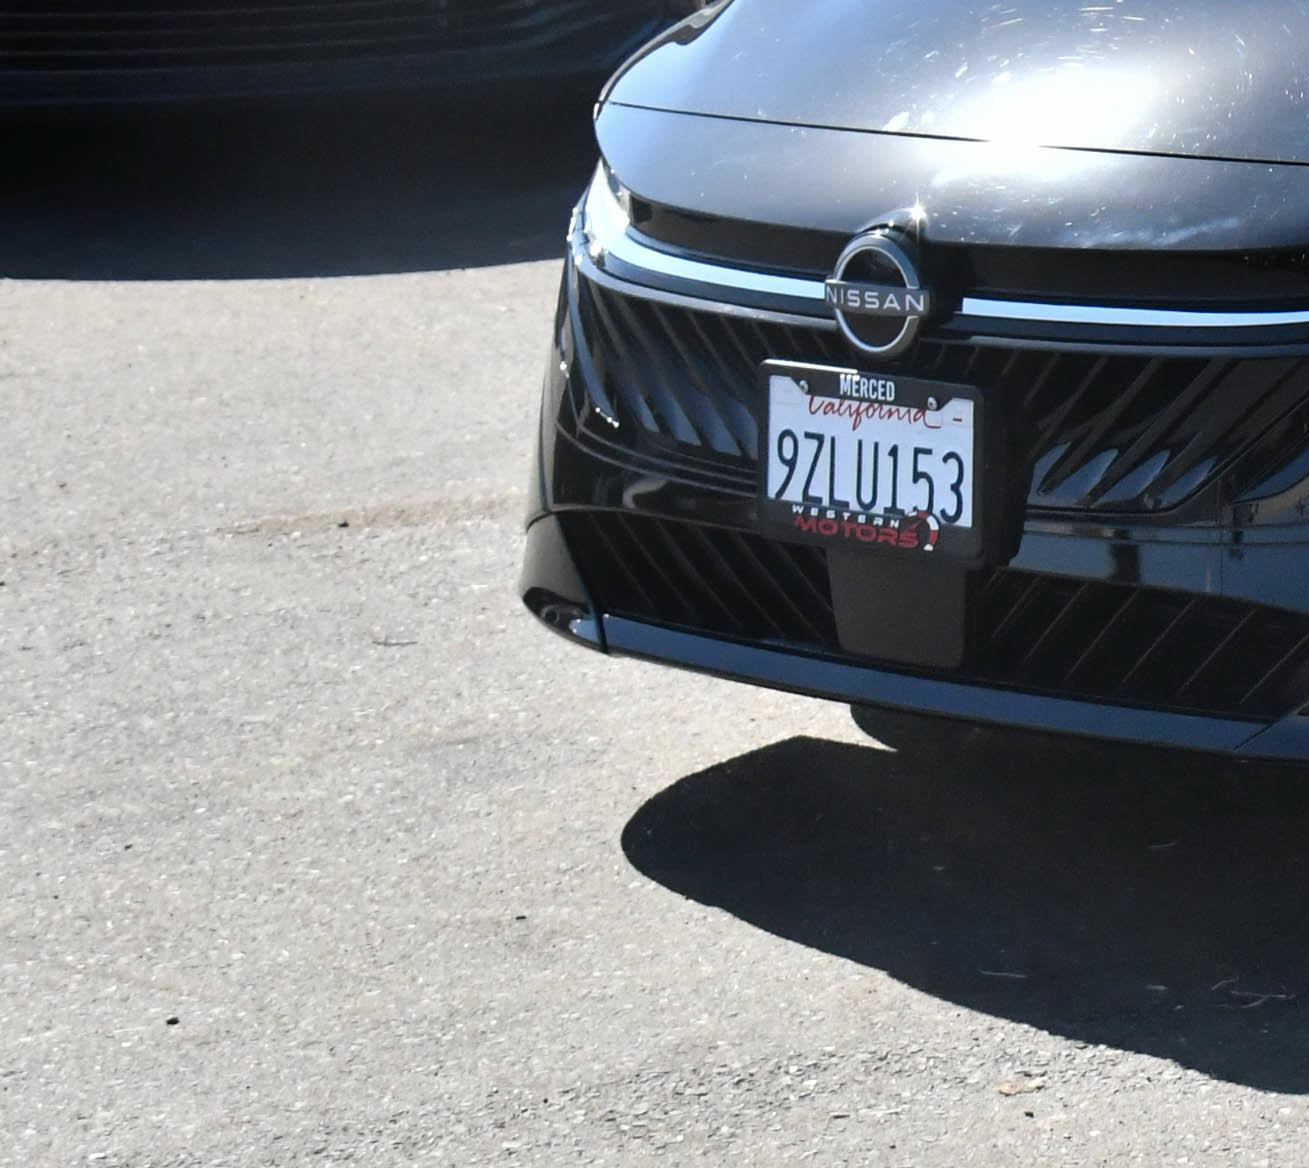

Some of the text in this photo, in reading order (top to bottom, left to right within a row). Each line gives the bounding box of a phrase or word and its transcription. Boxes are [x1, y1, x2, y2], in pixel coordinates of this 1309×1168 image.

[826, 285, 925, 312] NISSAN
[838, 373, 896, 402] MERCED
[774, 428, 965, 524] 9ZLU153
[791, 504, 900, 529] WESTERN
[793, 516, 920, 549] MOTORS
